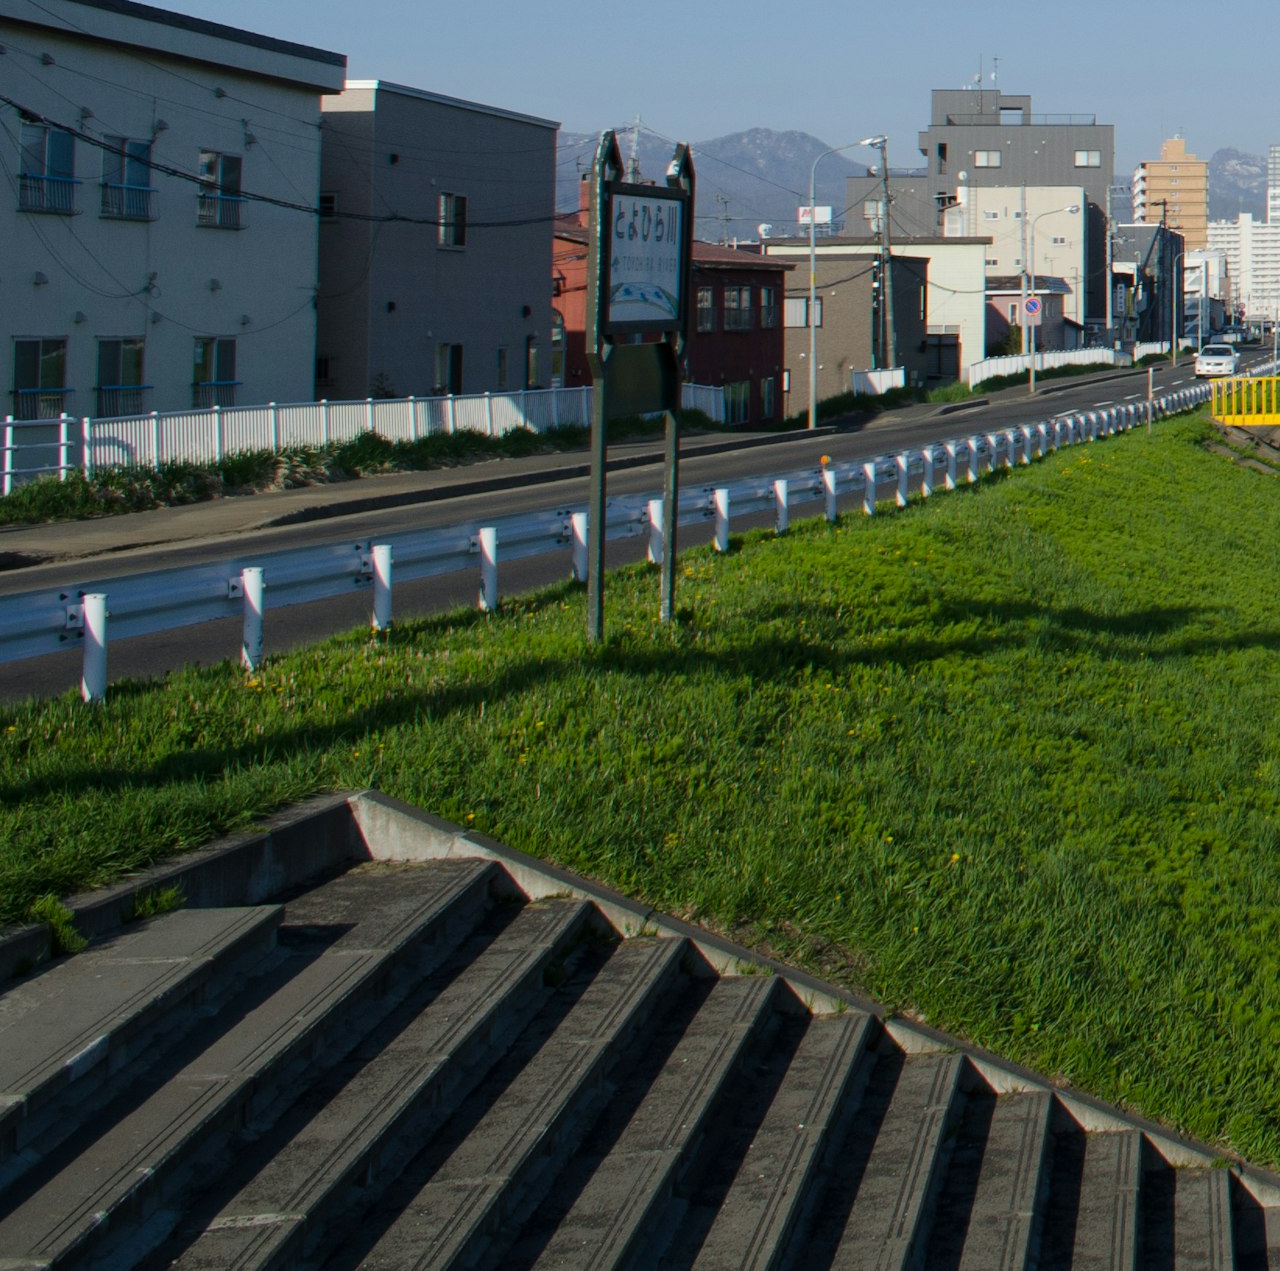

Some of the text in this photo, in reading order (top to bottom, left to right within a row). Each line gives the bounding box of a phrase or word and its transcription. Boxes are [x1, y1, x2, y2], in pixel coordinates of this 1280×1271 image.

[616, 201, 677, 244] とよひら川
[658, 257, 677, 273] RIVER
